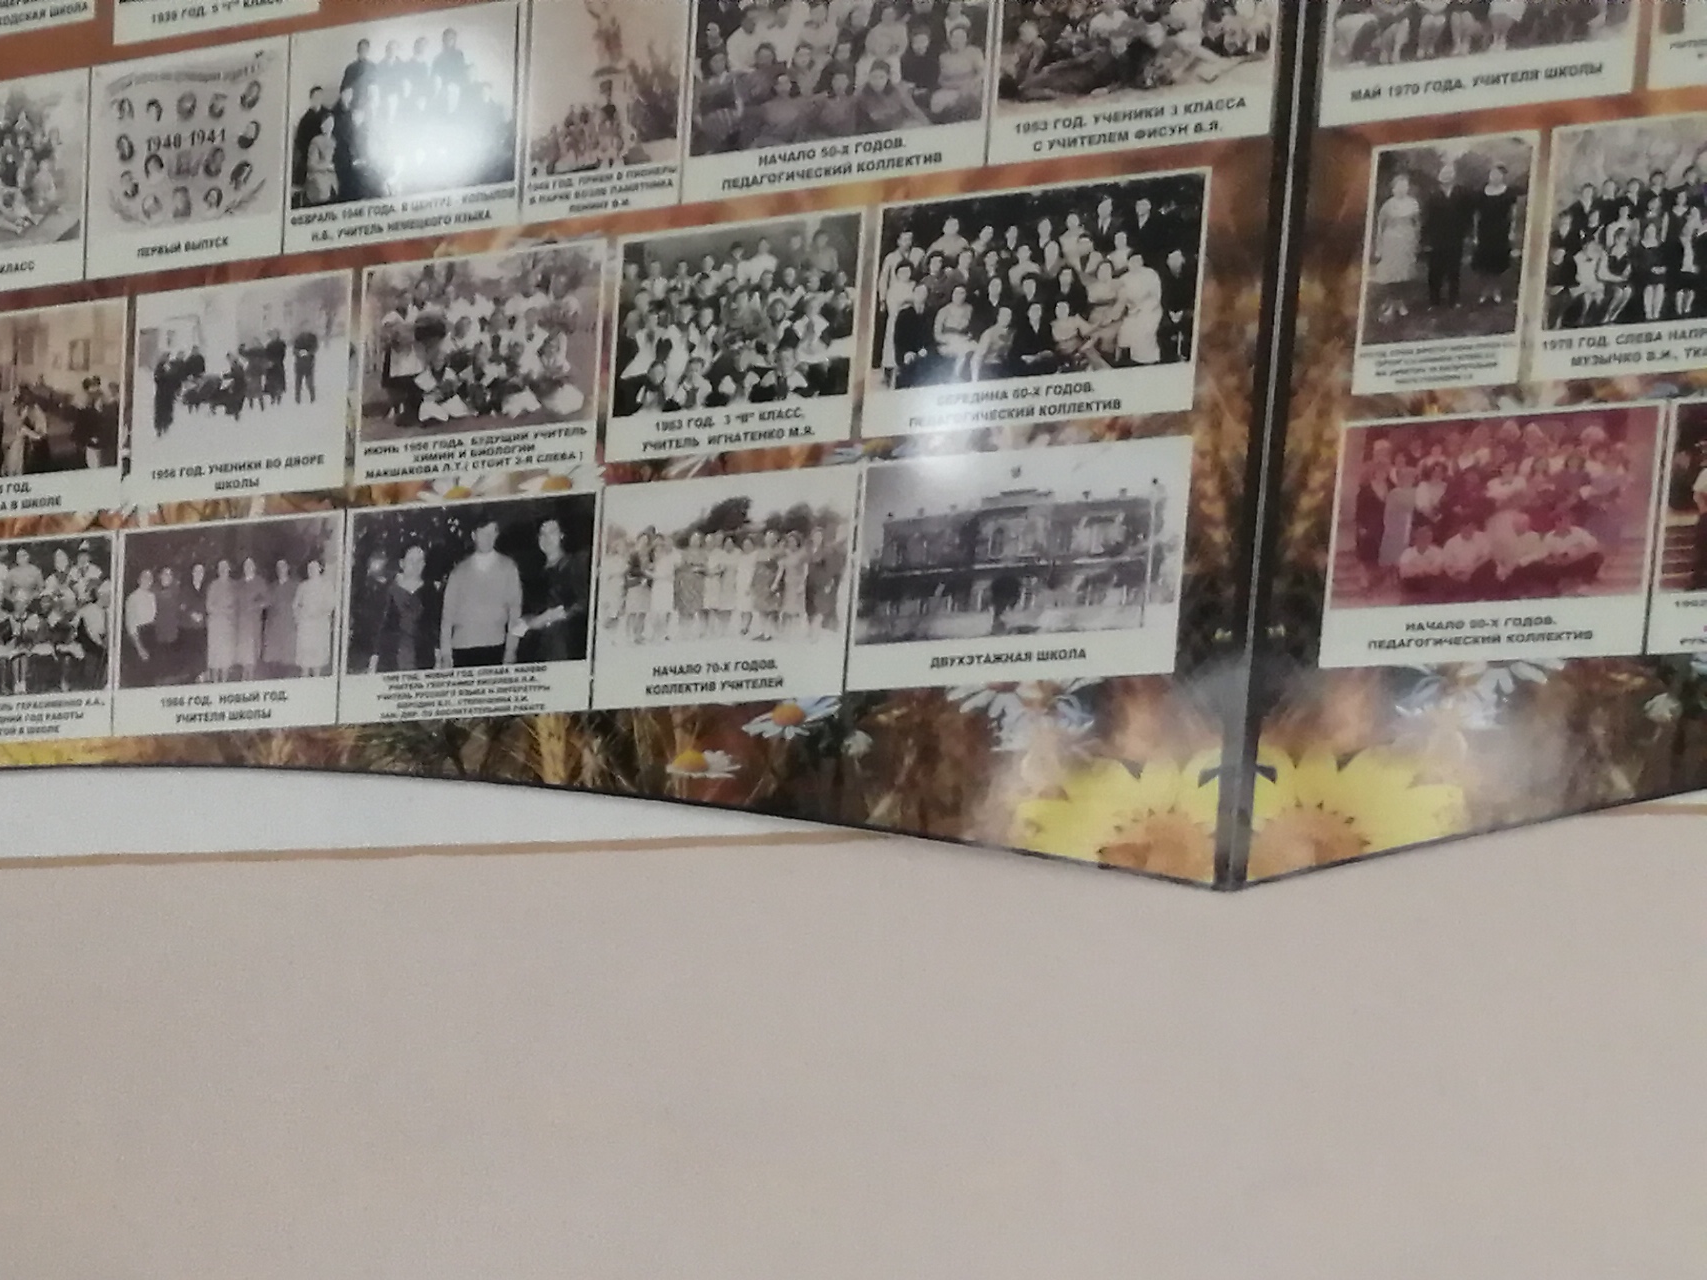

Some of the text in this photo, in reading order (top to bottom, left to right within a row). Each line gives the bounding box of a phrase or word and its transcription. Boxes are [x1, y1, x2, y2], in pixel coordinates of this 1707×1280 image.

[49, 2, 88, 19] ШКОЛА
[1472, 62, 1603, 89] УЧИТЕЛЯ ШКОЛЫ
[1053, 98, 1246, 129] ГОД. УЧЕНИКИ КЛАССА
[1033, 124, 1188, 151] С УЧИТЕЛЕМ ФИСУН
[758, 137, 907, 167] НАЧАЛО ГОДОВ.
[722, 151, 942, 191] ПЕДАГОГИЧЕСКИЙ КОЛЛЕКТИВ
[290, 212, 337, 226] ФЕВРАЛЬ
[337, 222, 384, 239] УЧИТЕЛЬ
[184, 235, 229, 253] ВЫПУСК
[0, 260, 35, 274] КЛАСС
[1616, 331, 1662, 345] СЛЕВА
[1045, 381, 1094, 397] ГОДОВ.
[1038, 398, 1121, 416] КОЛЛЕКТИВ
[642, 428, 785, 452] УЧИТЕЛЬ ИГНАТЕНКО
[179, 454, 325, 478] ГОД. УЧЕНИКИ ВО ДВОРЕ
[215, 478, 260, 491] ШКОЛЫ
[10, 500, 18, 509] В
[21, 495, 61, 509] ШКОЛЕ
[1405, 621, 1465, 632] НАЧАЛО
[1368, 630, 1593, 650] ПЕДАГОГИЧЕСКИЙ КОЛЛЕКТИВ
[931, 648, 1086, 669] ДВУХЭТАЖНАЯ ШКОЛА
[652, 664, 702, 677] НАЧАЛО
[645, 677, 783, 696] КОЛЛЕКТИВ УЧИТЕЛЕЙ
[228, 708, 271, 721] ШКОЛЫ
